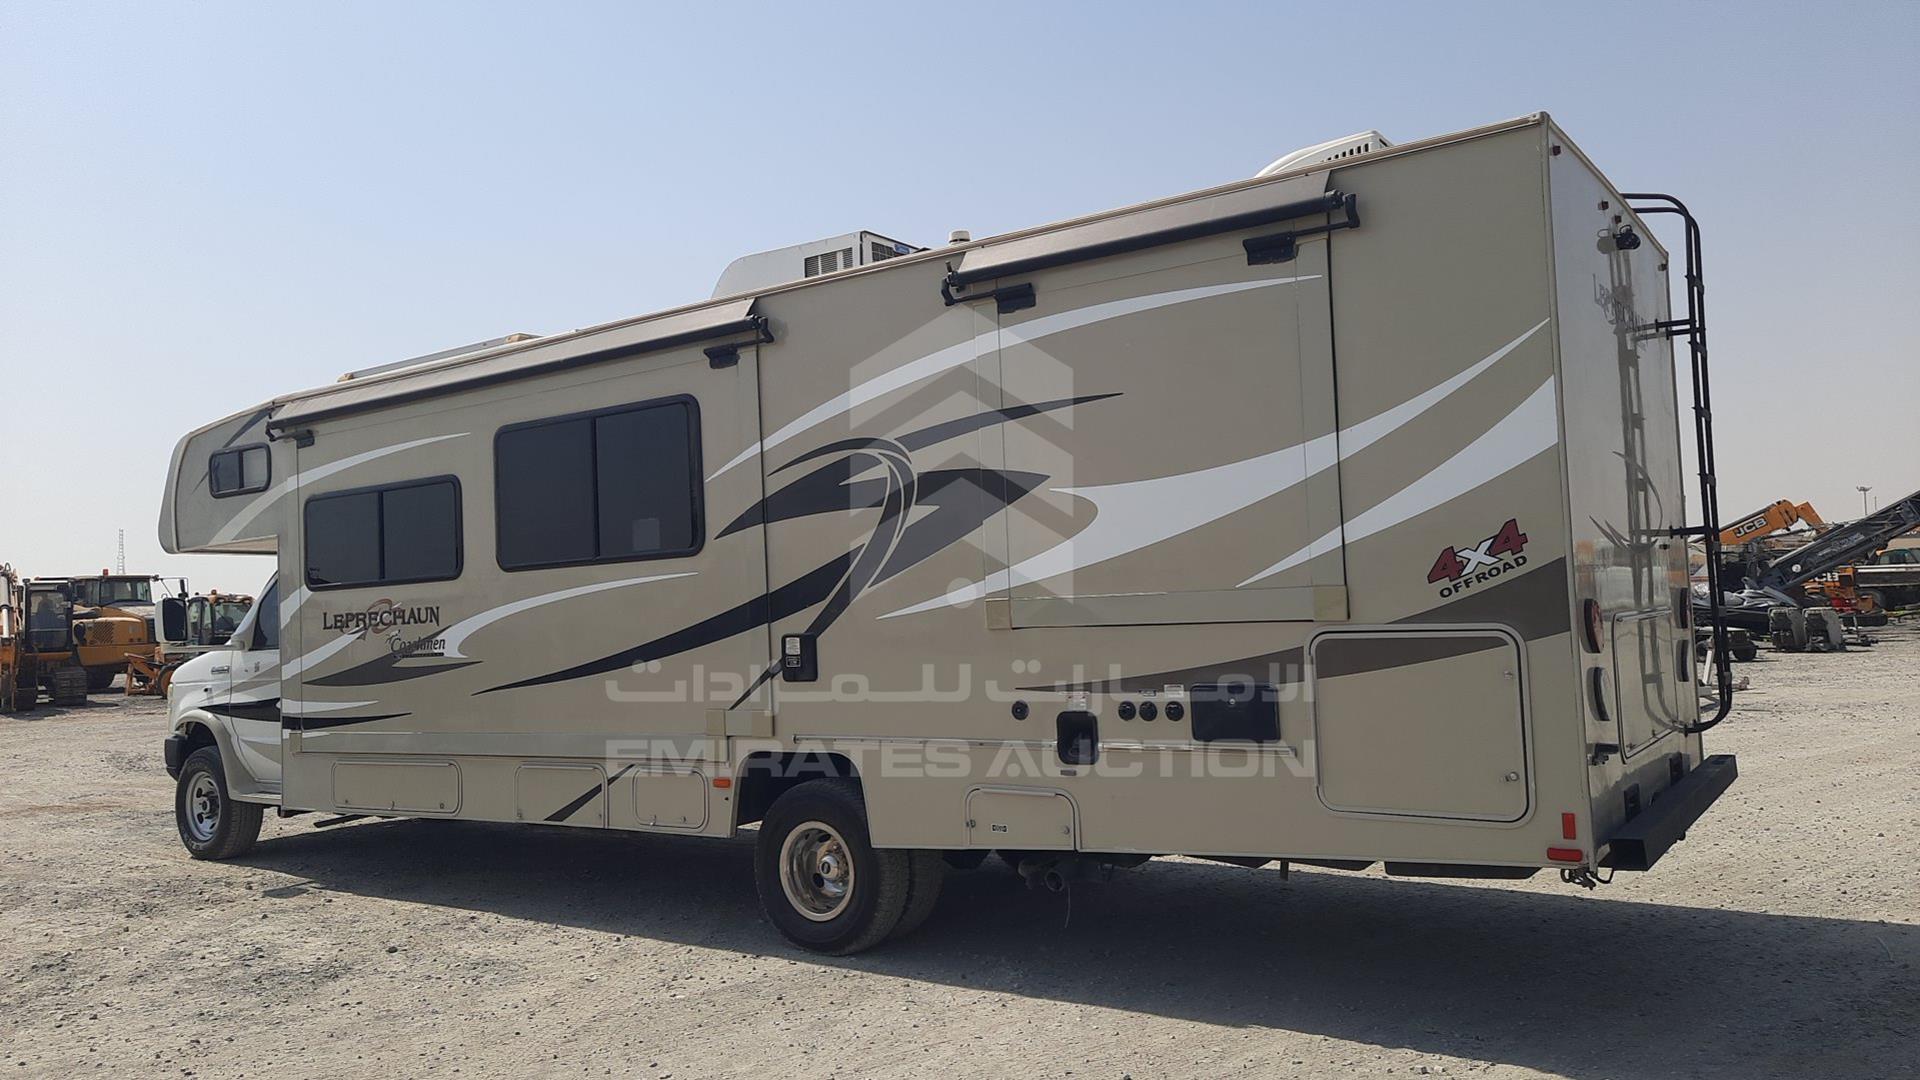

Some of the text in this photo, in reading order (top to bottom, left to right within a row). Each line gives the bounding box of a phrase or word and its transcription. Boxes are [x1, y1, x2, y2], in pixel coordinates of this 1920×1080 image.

[1735, 516, 1766, 537] JCB
[1439, 555, 1528, 598] OFFROAD
[323, 606, 440, 630] LEPRECHAUN
